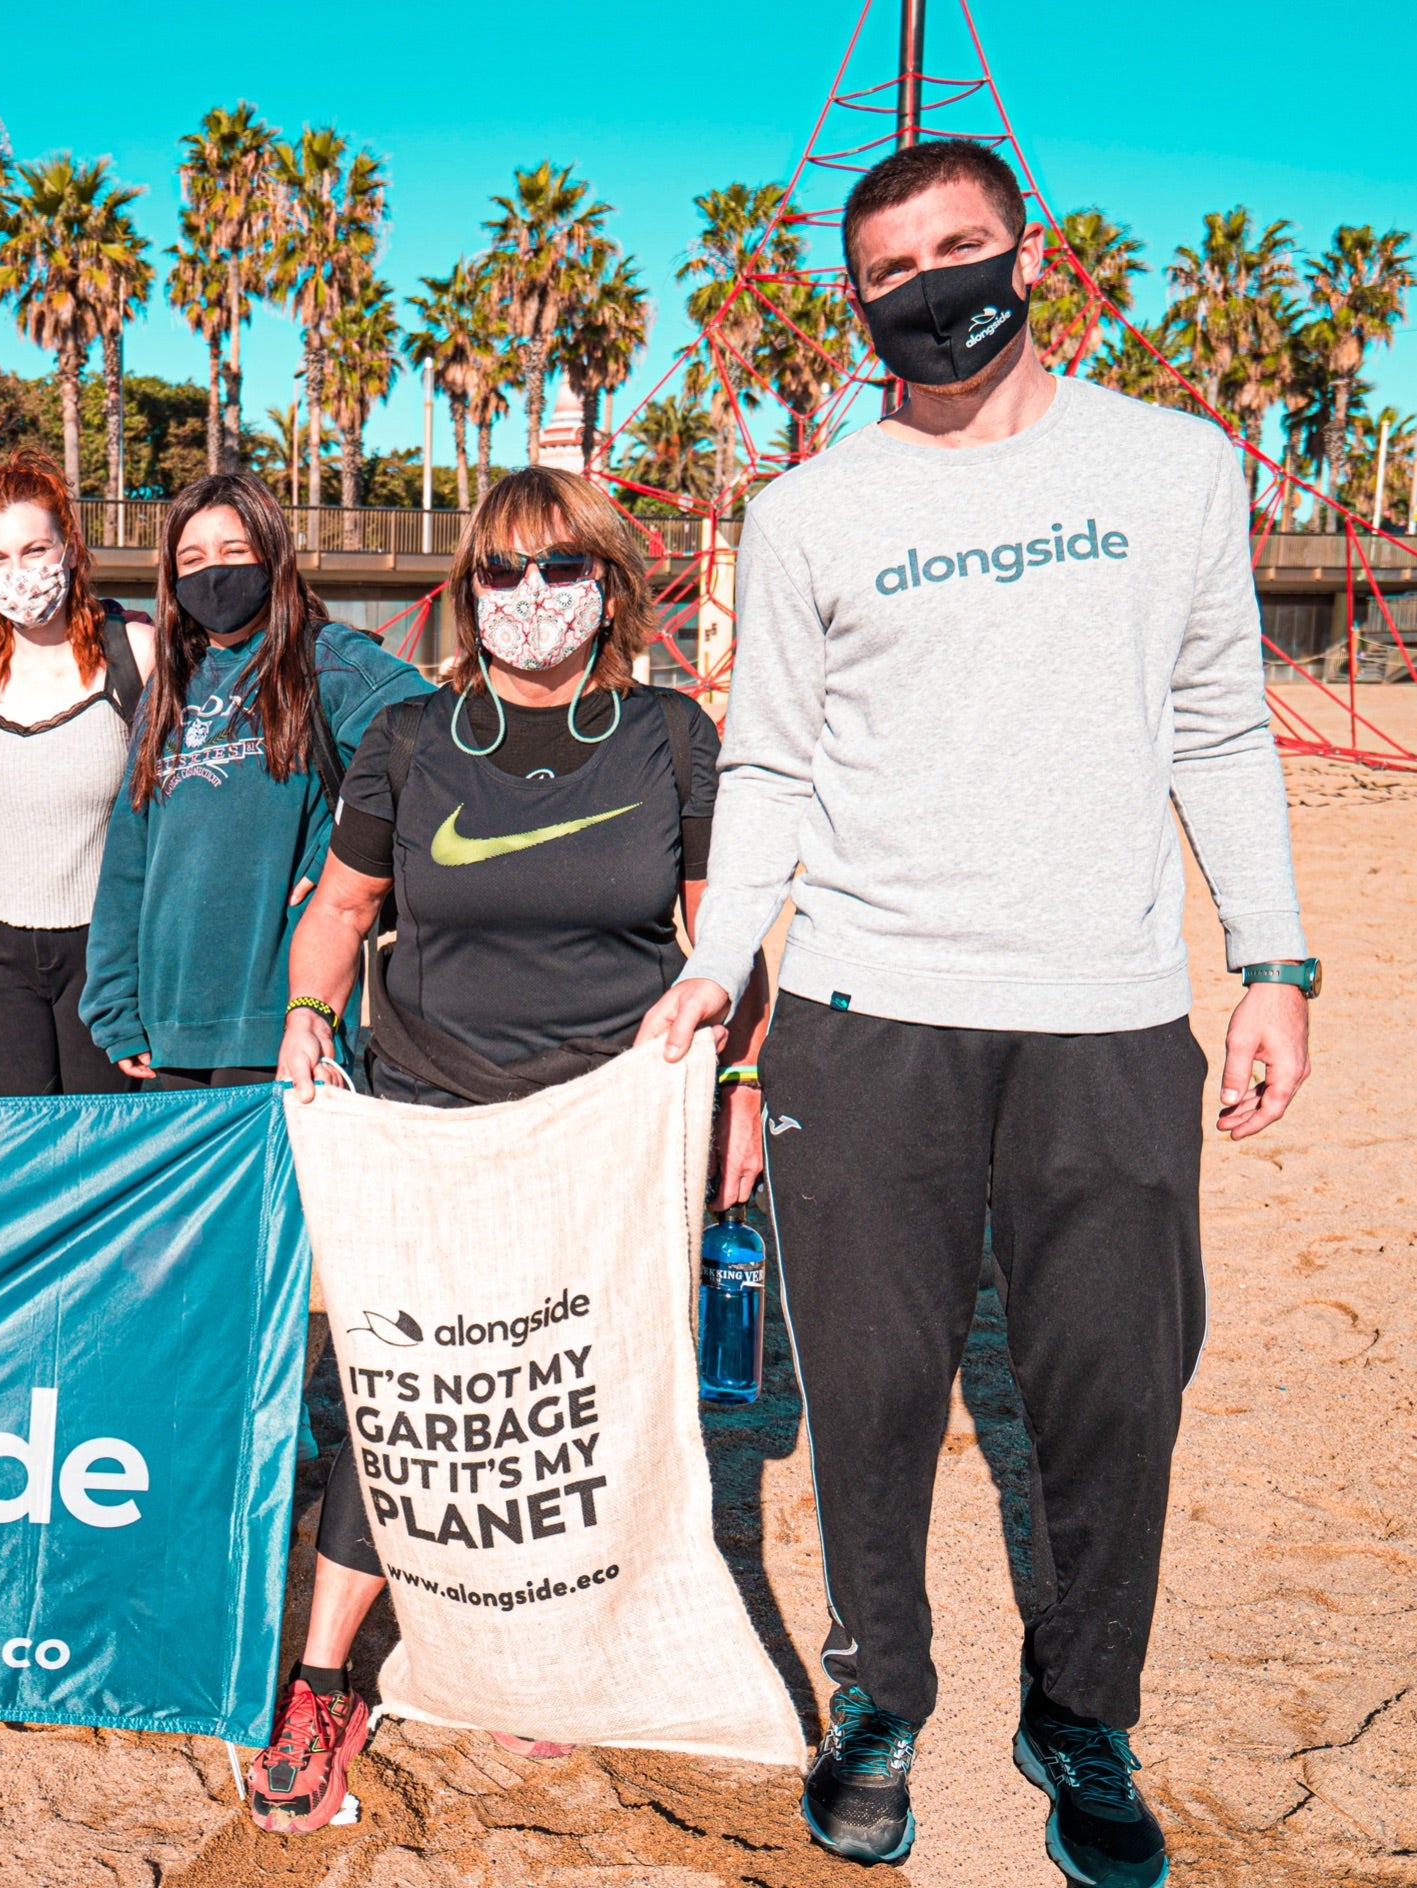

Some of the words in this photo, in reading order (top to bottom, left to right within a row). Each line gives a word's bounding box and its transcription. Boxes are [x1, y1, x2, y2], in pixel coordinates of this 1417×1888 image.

[965, 311, 1012, 348] alongside
[875, 518, 1129, 596] alongside
[434, 1287, 591, 1347] alongside
[348, 1365, 421, 1402] IT'S
[433, 1365, 522, 1405] NOT
[529, 1344, 593, 1392] MY
[355, 1384, 599, 1453] GARBAGE
[361, 1447, 439, 1489] BUT
[449, 1455, 523, 1494] IT'S
[534, 1432, 600, 1481] MY
[369, 1475, 607, 1550] PLANET
[386, 1563, 620, 1612] www.alongside.eco
